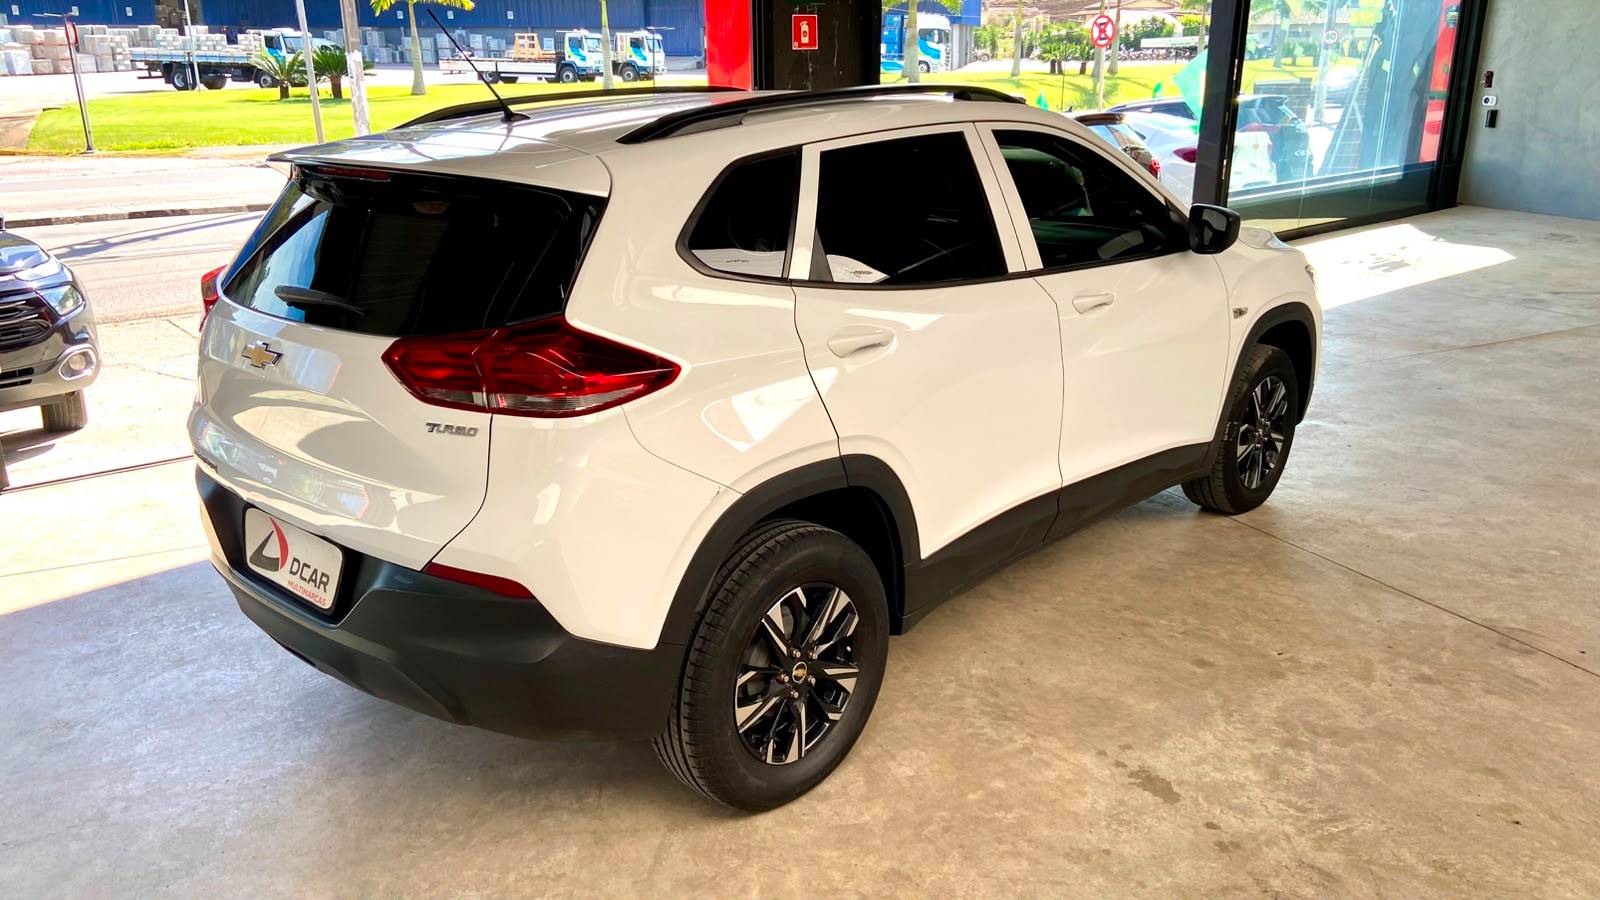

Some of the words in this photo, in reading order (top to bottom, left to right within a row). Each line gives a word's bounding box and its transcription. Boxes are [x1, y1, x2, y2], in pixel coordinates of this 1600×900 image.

[1325, 32, 1337, 40] 60
[425, 422, 479, 437] TURBO
[289, 557, 330, 593] DCAR
[287, 579, 327, 606] MULTIMARCAS
